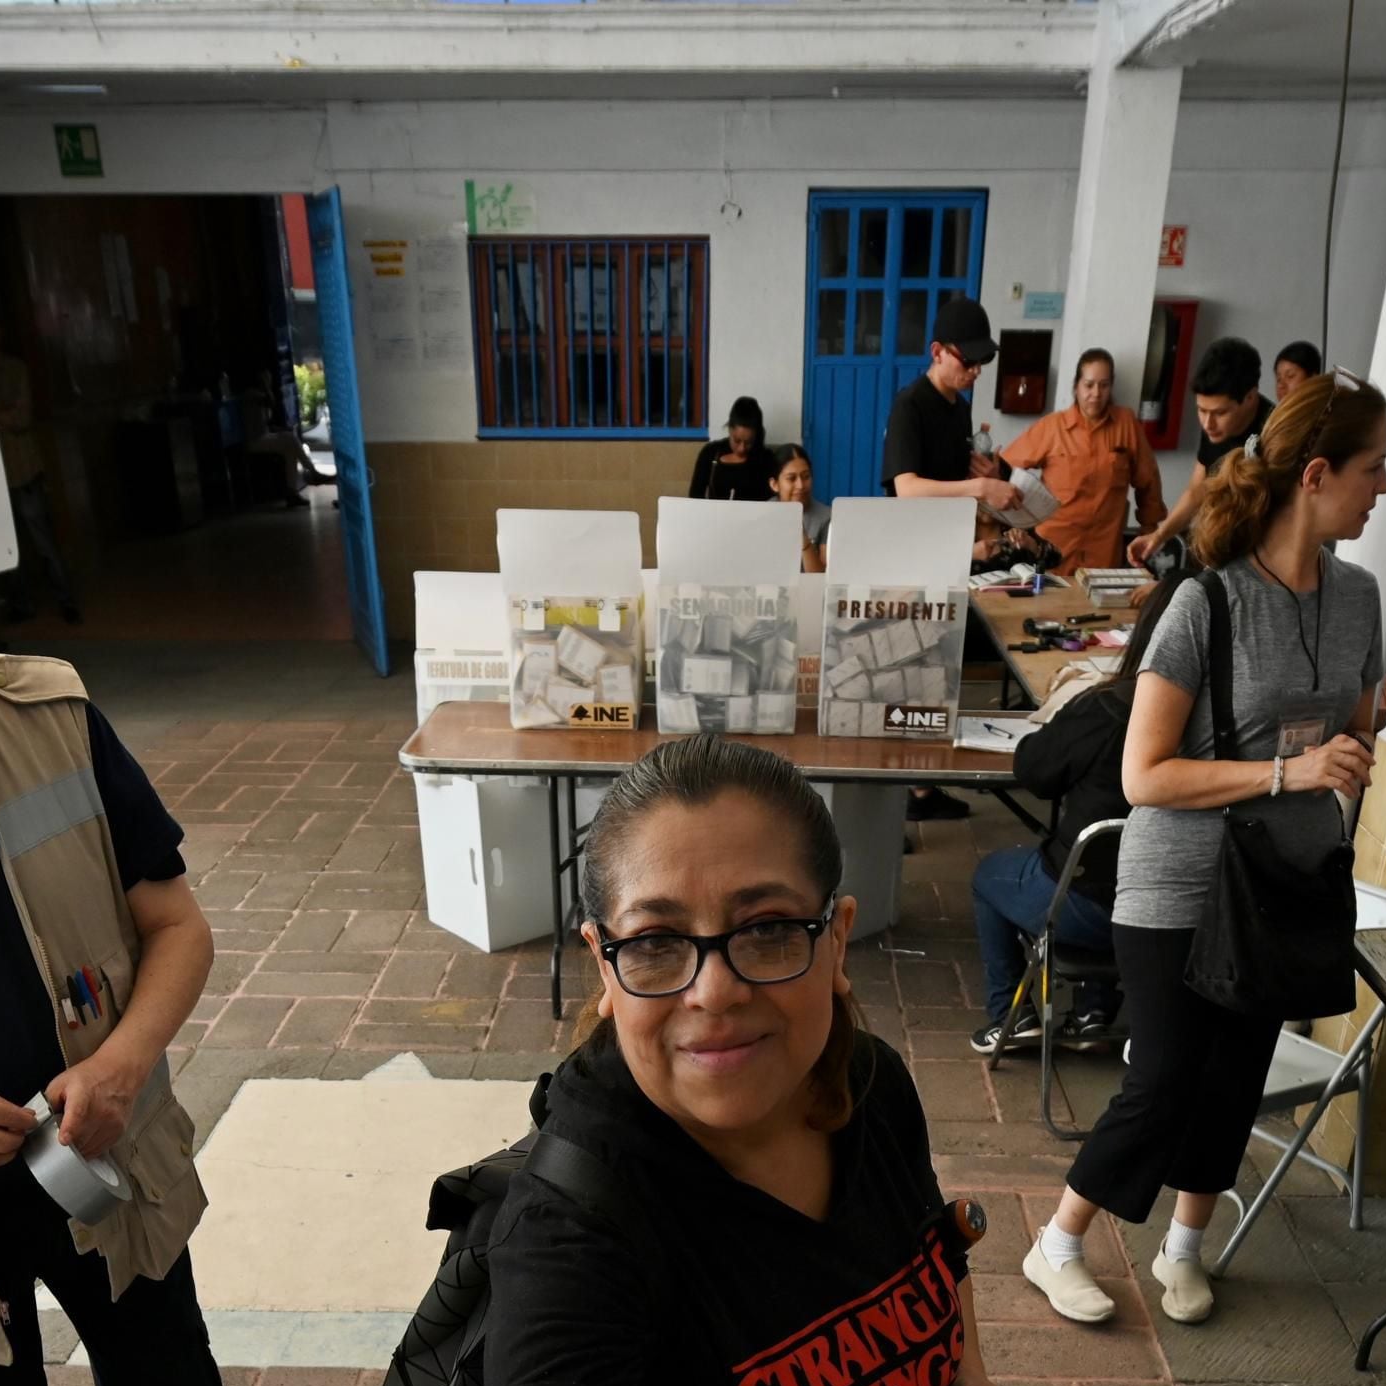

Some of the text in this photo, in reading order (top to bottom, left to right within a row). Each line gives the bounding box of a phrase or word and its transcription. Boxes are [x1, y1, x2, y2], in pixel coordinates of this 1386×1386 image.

[837, 599, 957, 621] PRESIDENTE
[471, 661, 483, 679] DE
[594, 706, 629, 722] INE
[907, 711, 947, 727] INE
